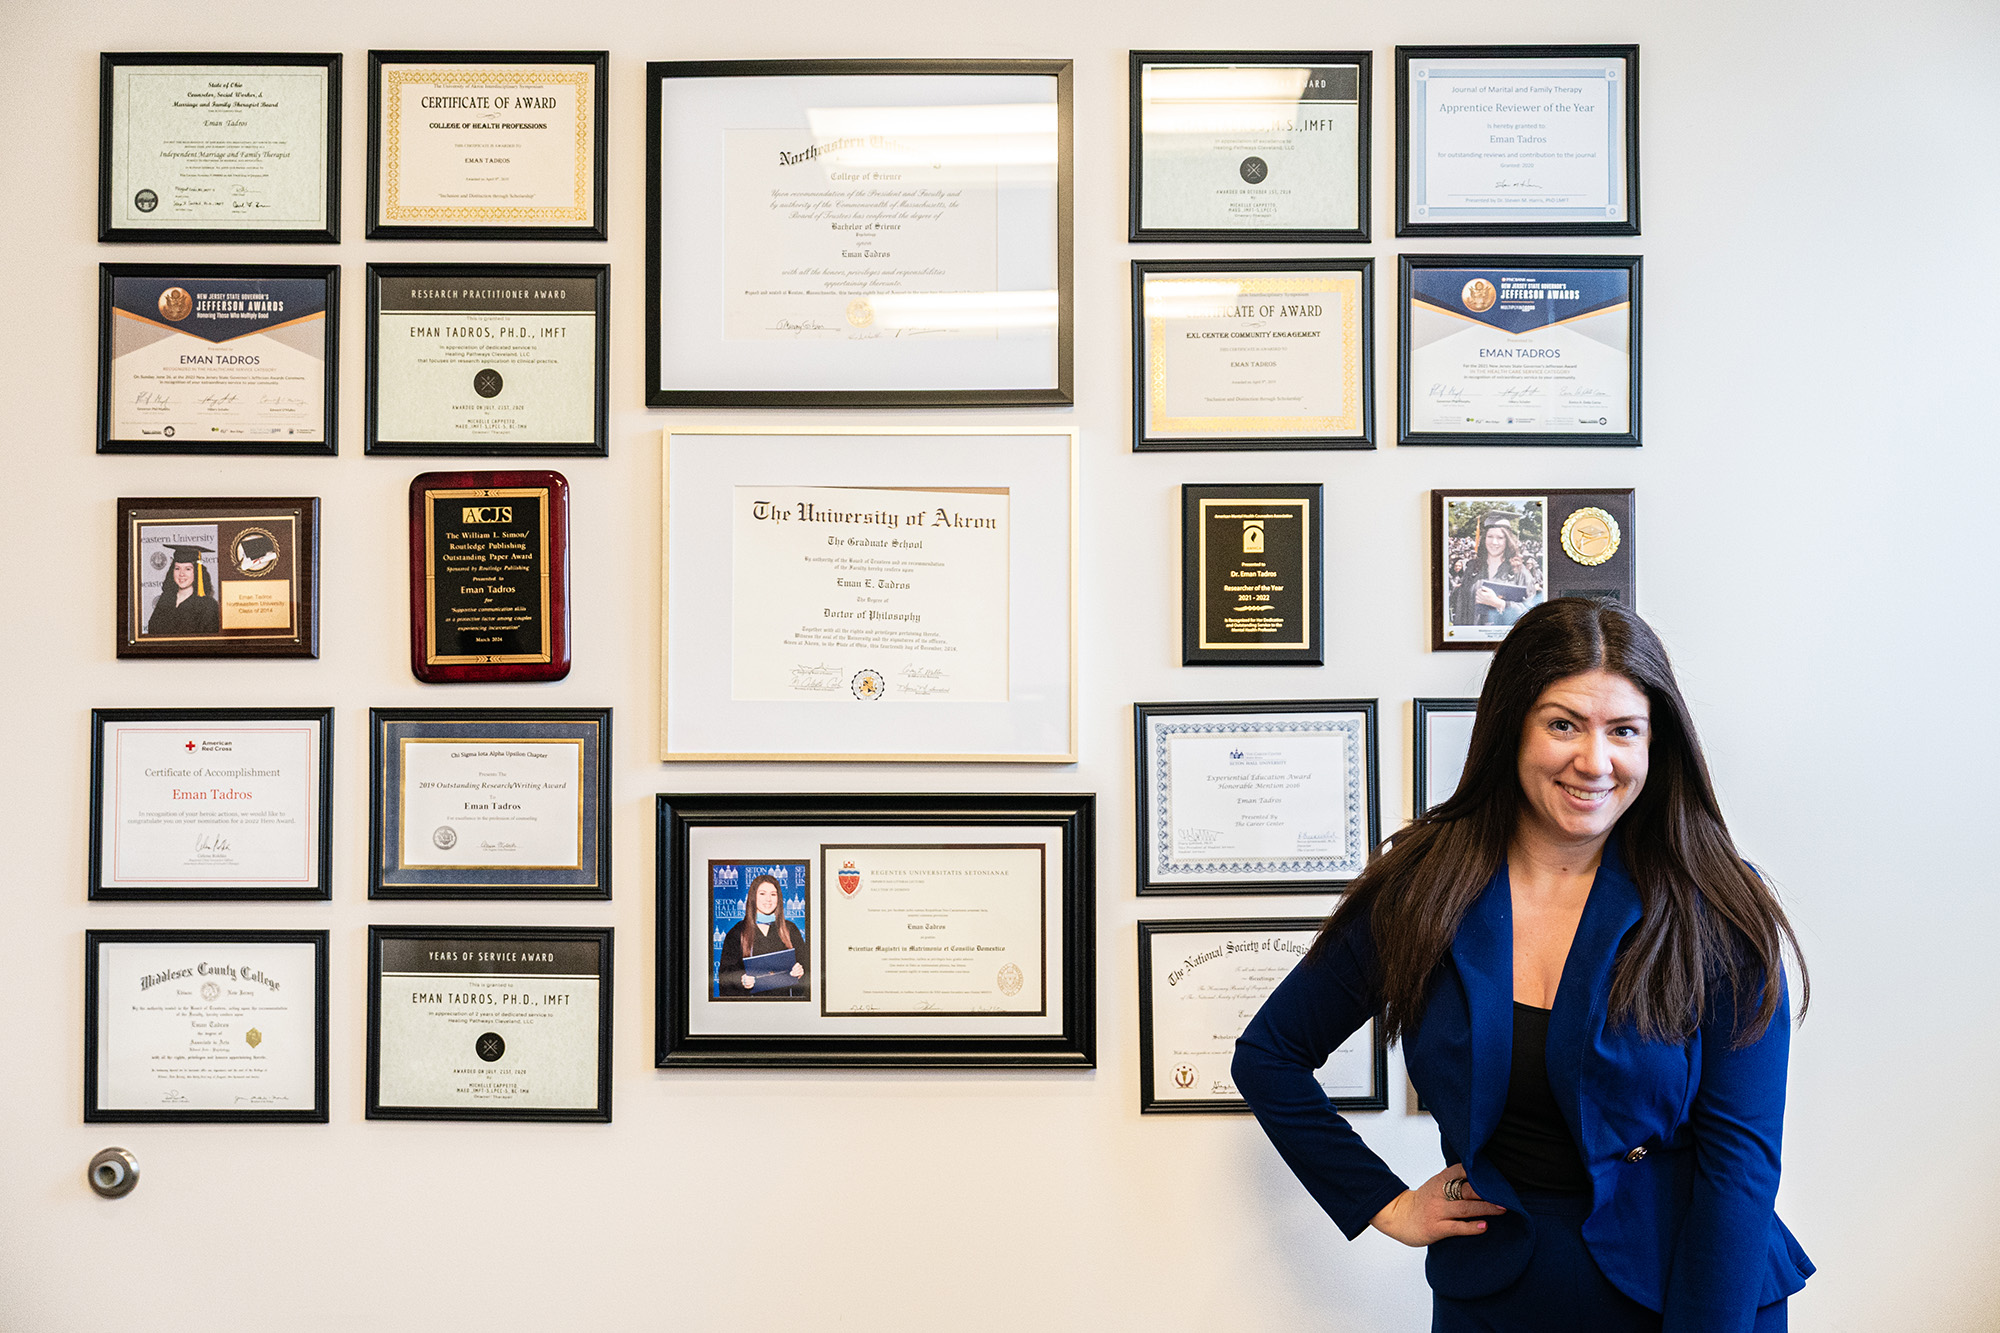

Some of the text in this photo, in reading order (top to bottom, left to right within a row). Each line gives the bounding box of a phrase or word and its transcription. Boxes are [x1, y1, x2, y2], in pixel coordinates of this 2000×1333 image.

[1530, 86, 1552, 95] Family
[1554, 86, 1582, 95] Therapy
[421, 97, 556, 109] CERTIFICATE OF AWARD
[1440, 103, 1595, 114] Apprentice Reviewer of the Year
[1490, 135, 1546, 143] Eman Tadros
[159, 151, 197, 159] Independent
[198, 151, 225, 160] Marriage
[240, 151, 261, 160] Family
[263, 151, 290, 159] Therapist
[1448, 151, 1482, 159] outstanding
[842, 250, 890, 258] Eman Tadros
[411, 290, 566, 299] RESEARCH PRACTITIONER AWARD
[1500, 290, 1580, 300] JEFFERSON AWARDS
[196, 301, 283, 312] JEFFERSON AWARDS
[1259, 305, 1323, 317] OF AWARD
[410, 327, 567, 339] EMAN TADROS, PH.D., IMFT
[1480, 349, 1560, 358] EMAN TADROS
[180, 355, 260, 365] EMAN TADROS
[462, 507, 512, 523] ACJS
[752, 501, 997, 529] The University of Akron
[173, 533, 215, 543] University
[827, 536, 923, 549] The Graduate School
[450, 542, 526, 551] Routledge Publishing
[443, 554, 486, 562] Outstanding
[837, 578, 910, 590] Eman E. Tadros
[461, 586, 484, 594] Eman
[824, 608, 921, 623] Doctor of Philosophy
[145, 768, 280, 779] Certificate of Accomplishment
[1207, 774, 1250, 782] Experiential
[436, 782, 480, 790] Outstanding
[481, 782, 541, 790] Research/Writing
[172, 789, 252, 800] Eman Tadros
[464, 802, 521, 810] Eman Tadros
[429, 952, 554, 962] YEARS OF SERVICE AWARD
[1167, 968, 1184, 987] The
[1183, 946, 1223, 975] National
[1225, 940, 1259, 959] Society
[1262, 938, 1271, 951] of
[140, 962, 281, 992] Middlesex County College
[412, 993, 570, 1006] EMAN TADROS, PH.D., IMFT
